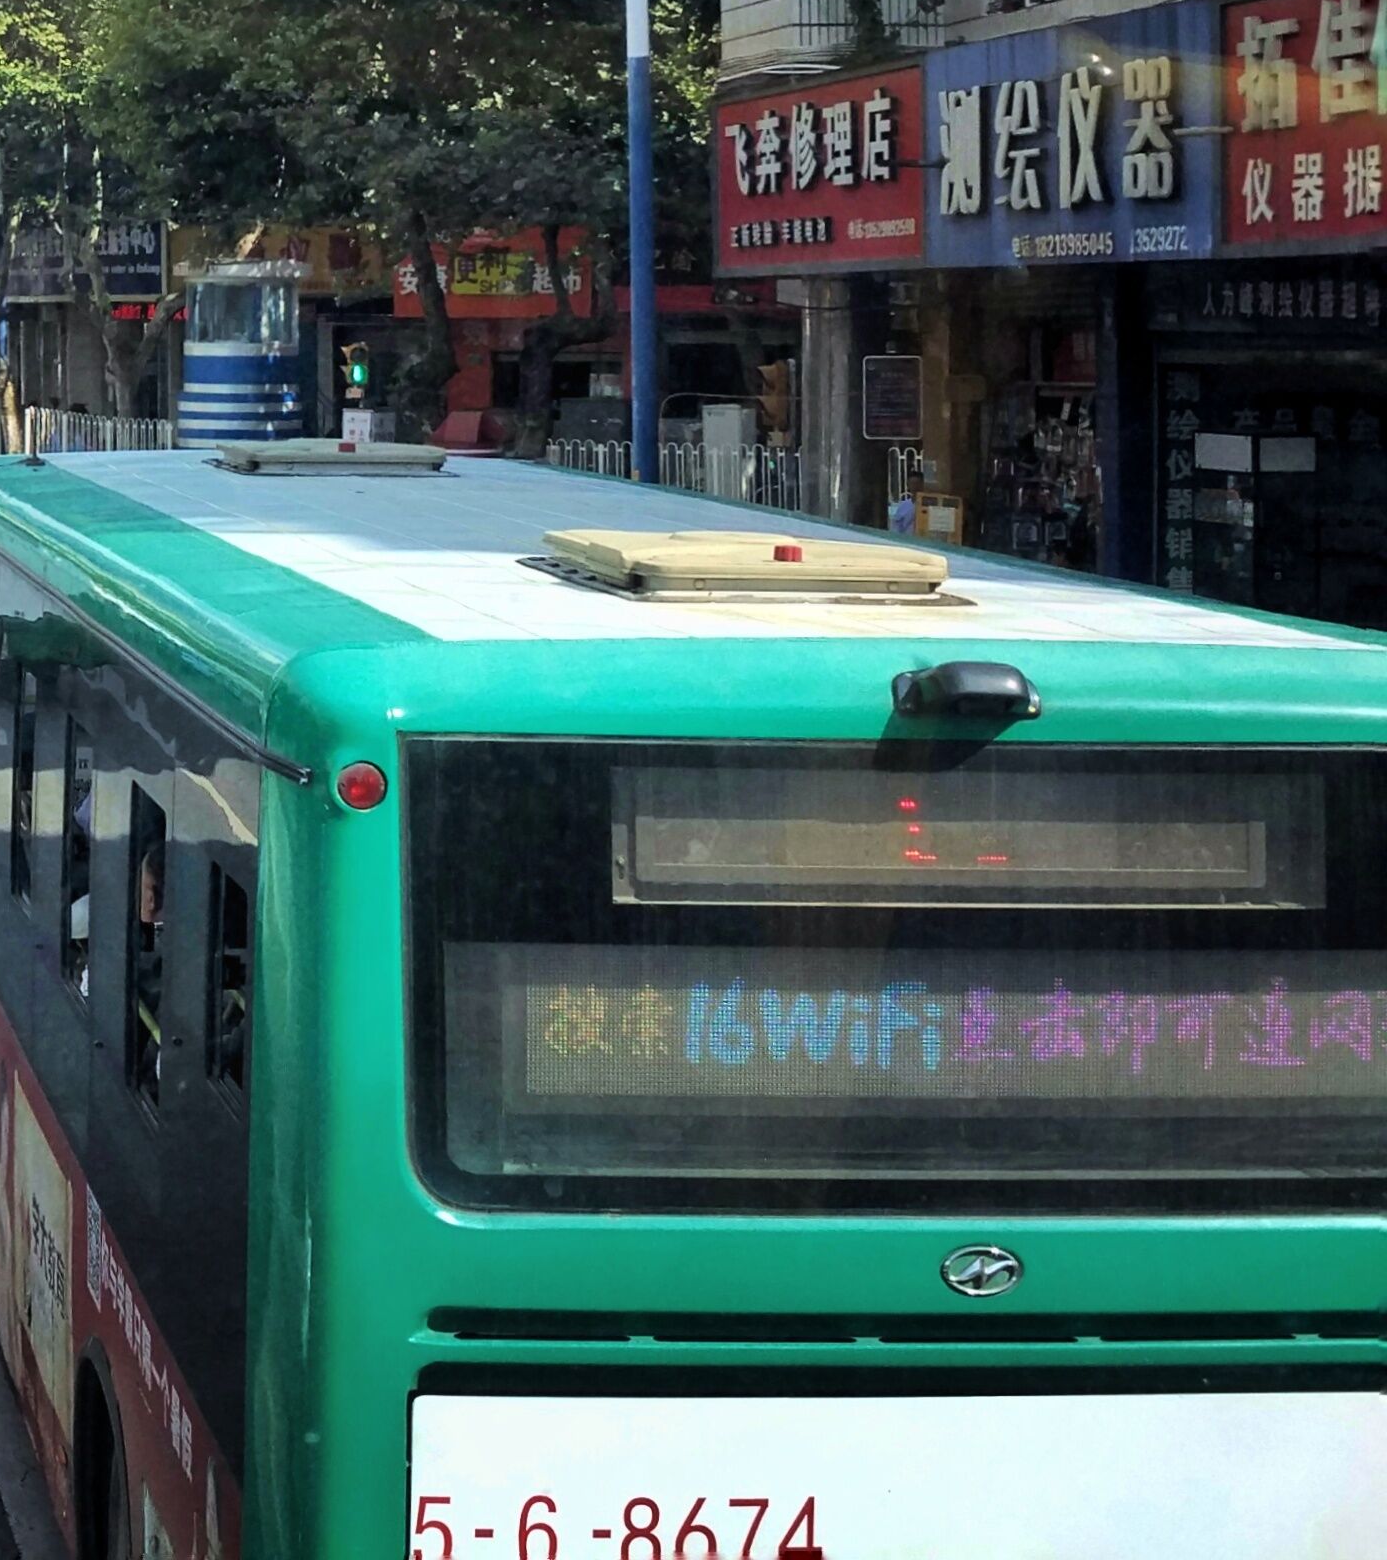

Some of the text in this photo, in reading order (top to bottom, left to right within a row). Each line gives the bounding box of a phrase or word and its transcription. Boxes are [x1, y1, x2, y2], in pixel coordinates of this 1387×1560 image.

[725, 90, 896, 197] 飞奔修理店
[938, 57, 1174, 217] 测绘仪器
[413, 1494, 824, 1560] 5-6-8674
